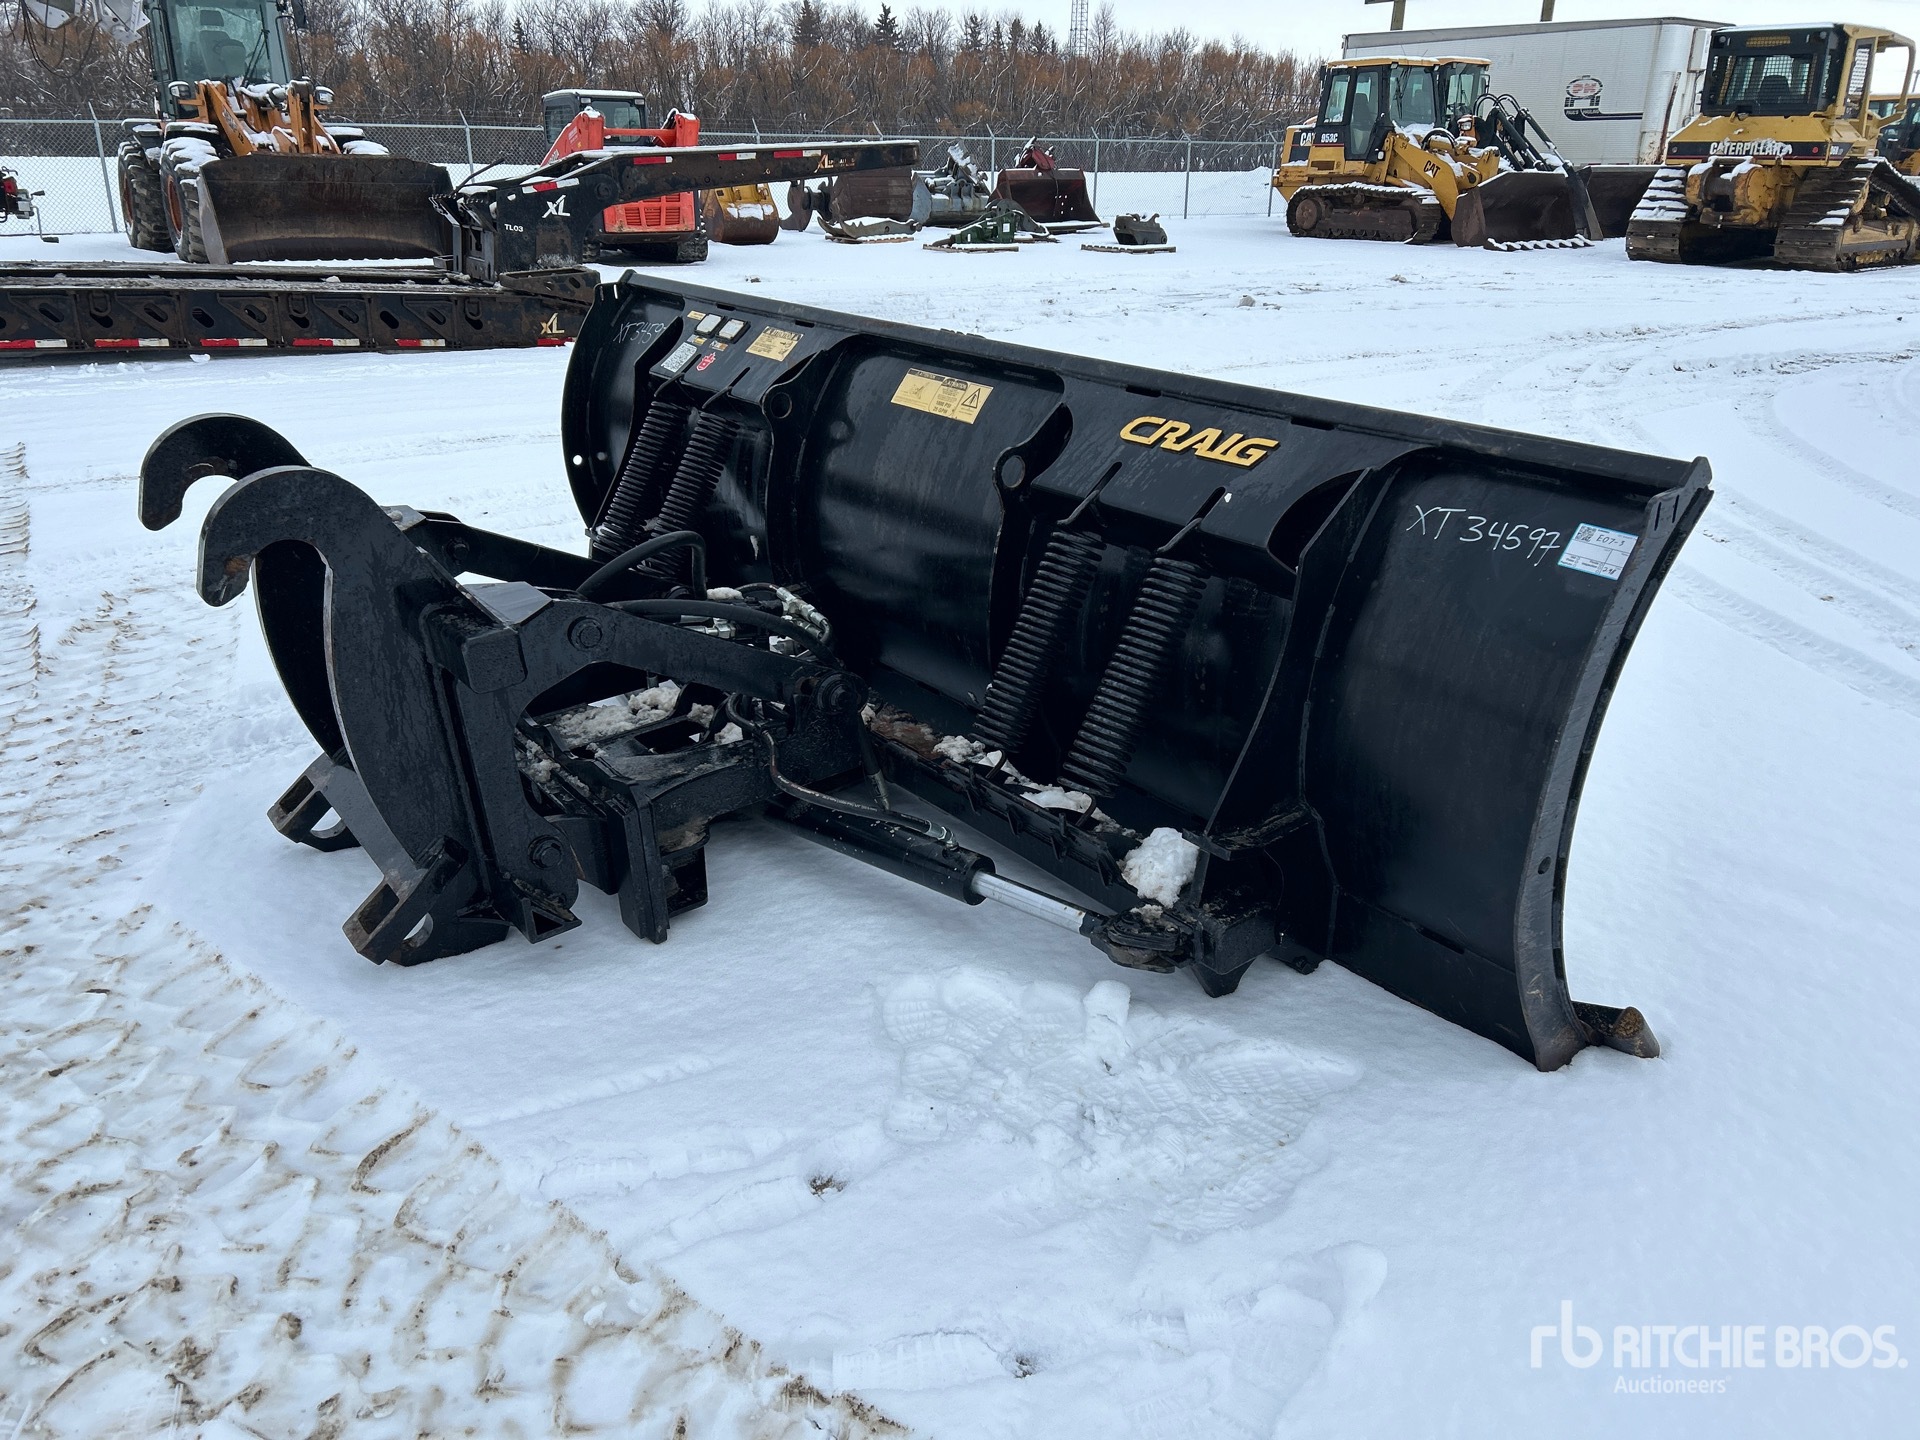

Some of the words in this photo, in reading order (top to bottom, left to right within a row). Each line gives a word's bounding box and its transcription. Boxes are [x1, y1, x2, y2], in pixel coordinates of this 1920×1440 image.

[1423, 160, 1441, 179] CAT
[542, 194, 570, 219] XL
[504, 223, 524, 233] TL03
[540, 312, 565, 335] XL
[612, 321, 667, 345] XT3459
[1119, 415, 1281, 468] CRAIG
